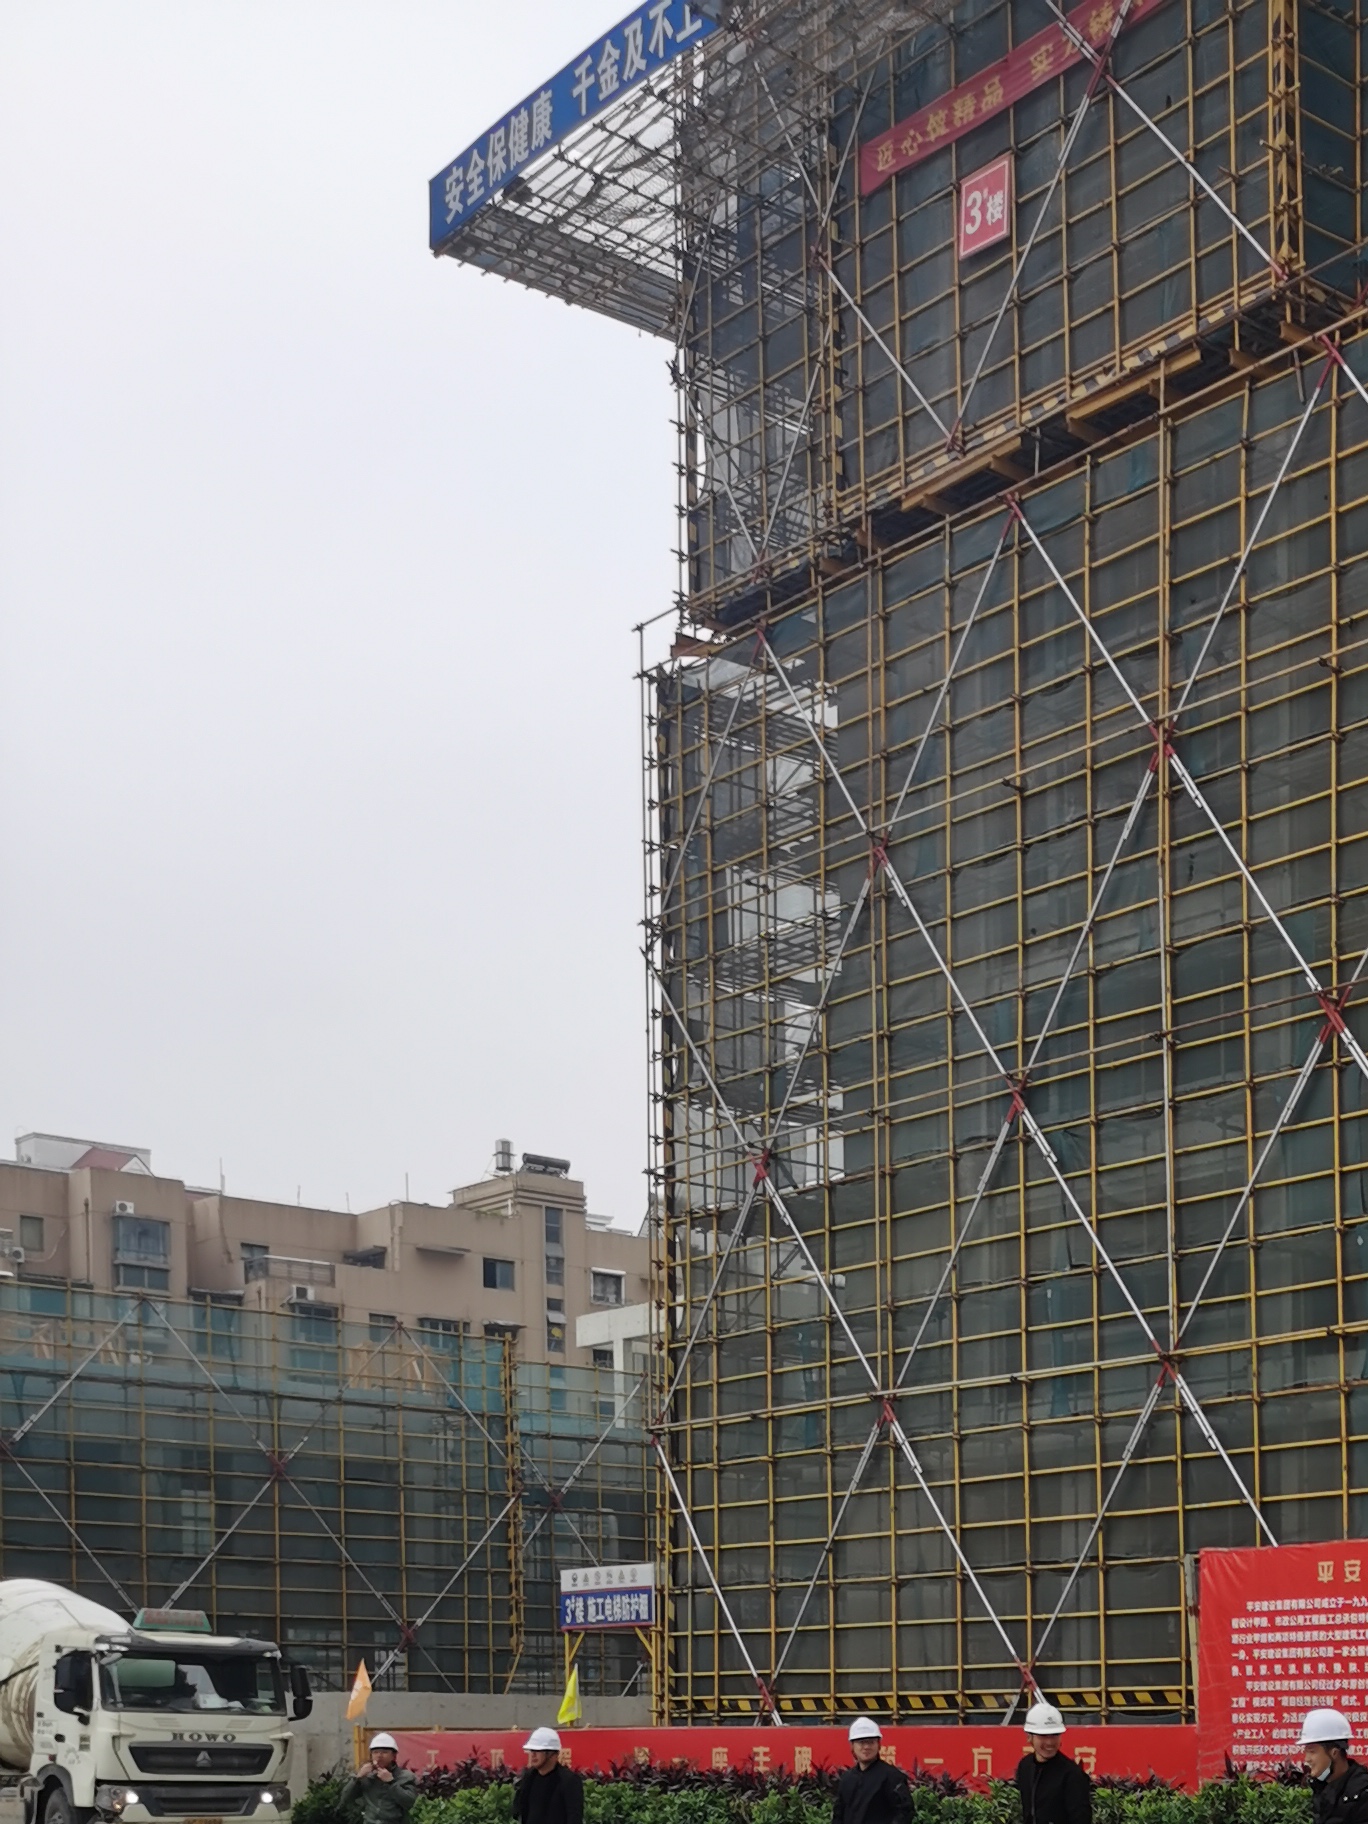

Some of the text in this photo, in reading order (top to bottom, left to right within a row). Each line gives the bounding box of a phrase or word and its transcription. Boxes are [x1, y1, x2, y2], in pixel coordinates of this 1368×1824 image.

[444, 90, 553, 224] 安全保健康
[171, 1732, 237, 1742] HOWO
